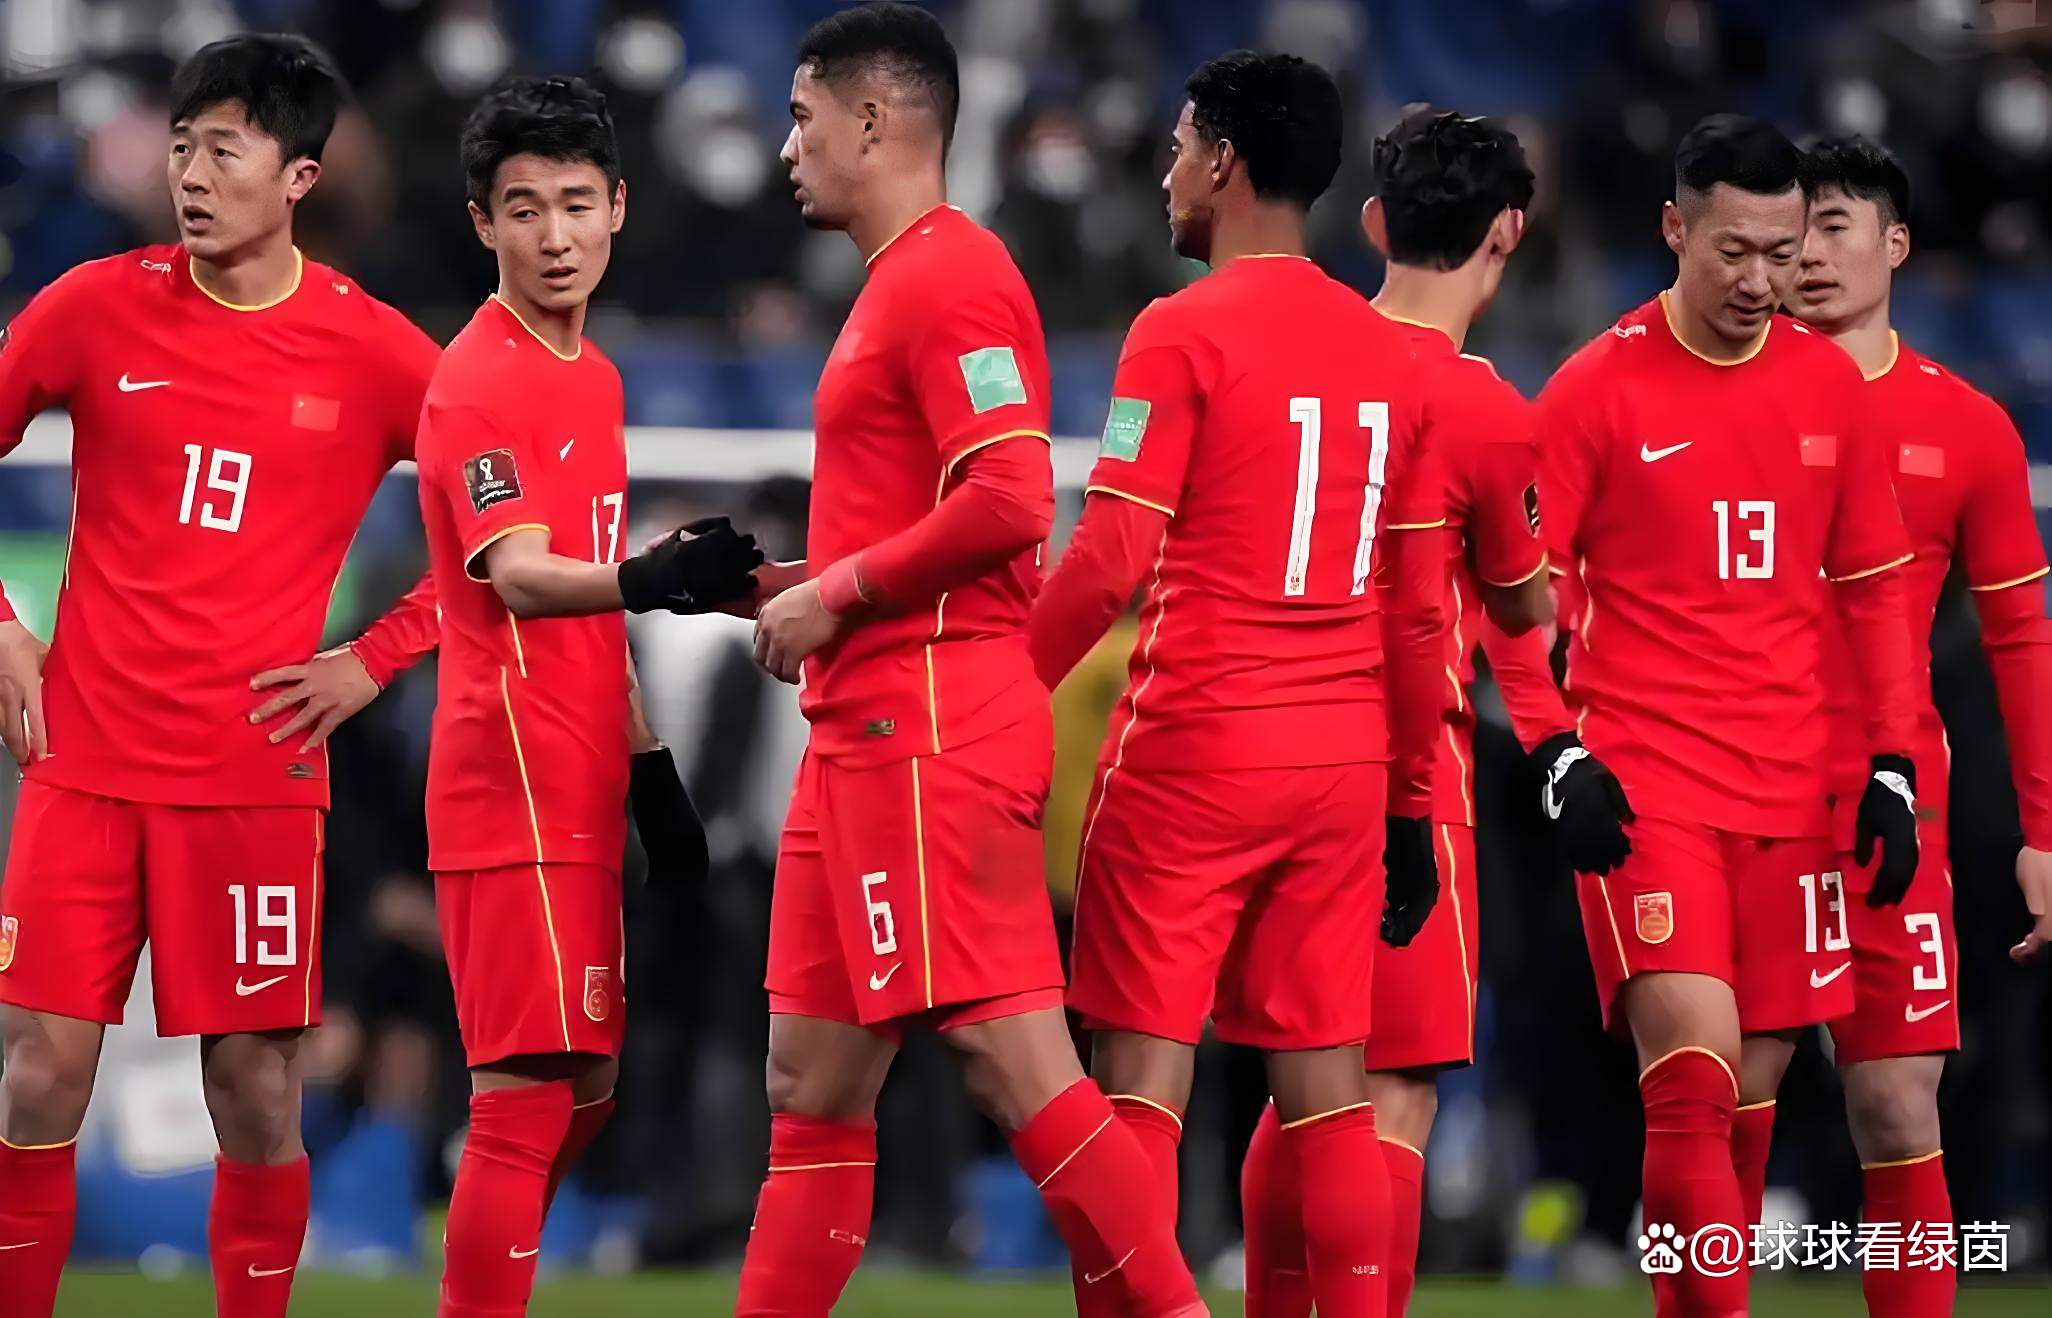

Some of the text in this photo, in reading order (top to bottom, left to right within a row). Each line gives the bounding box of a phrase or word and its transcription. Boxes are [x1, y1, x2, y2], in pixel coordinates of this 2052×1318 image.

[179, 443, 252, 533] 19
[1284, 398, 1389, 596] 11
[1712, 500, 1775, 579] 13
[228, 884, 297, 966] 19
[862, 871, 897, 955] 6
[1799, 871, 1851, 952] 13
[1904, 912, 1947, 990] 3
